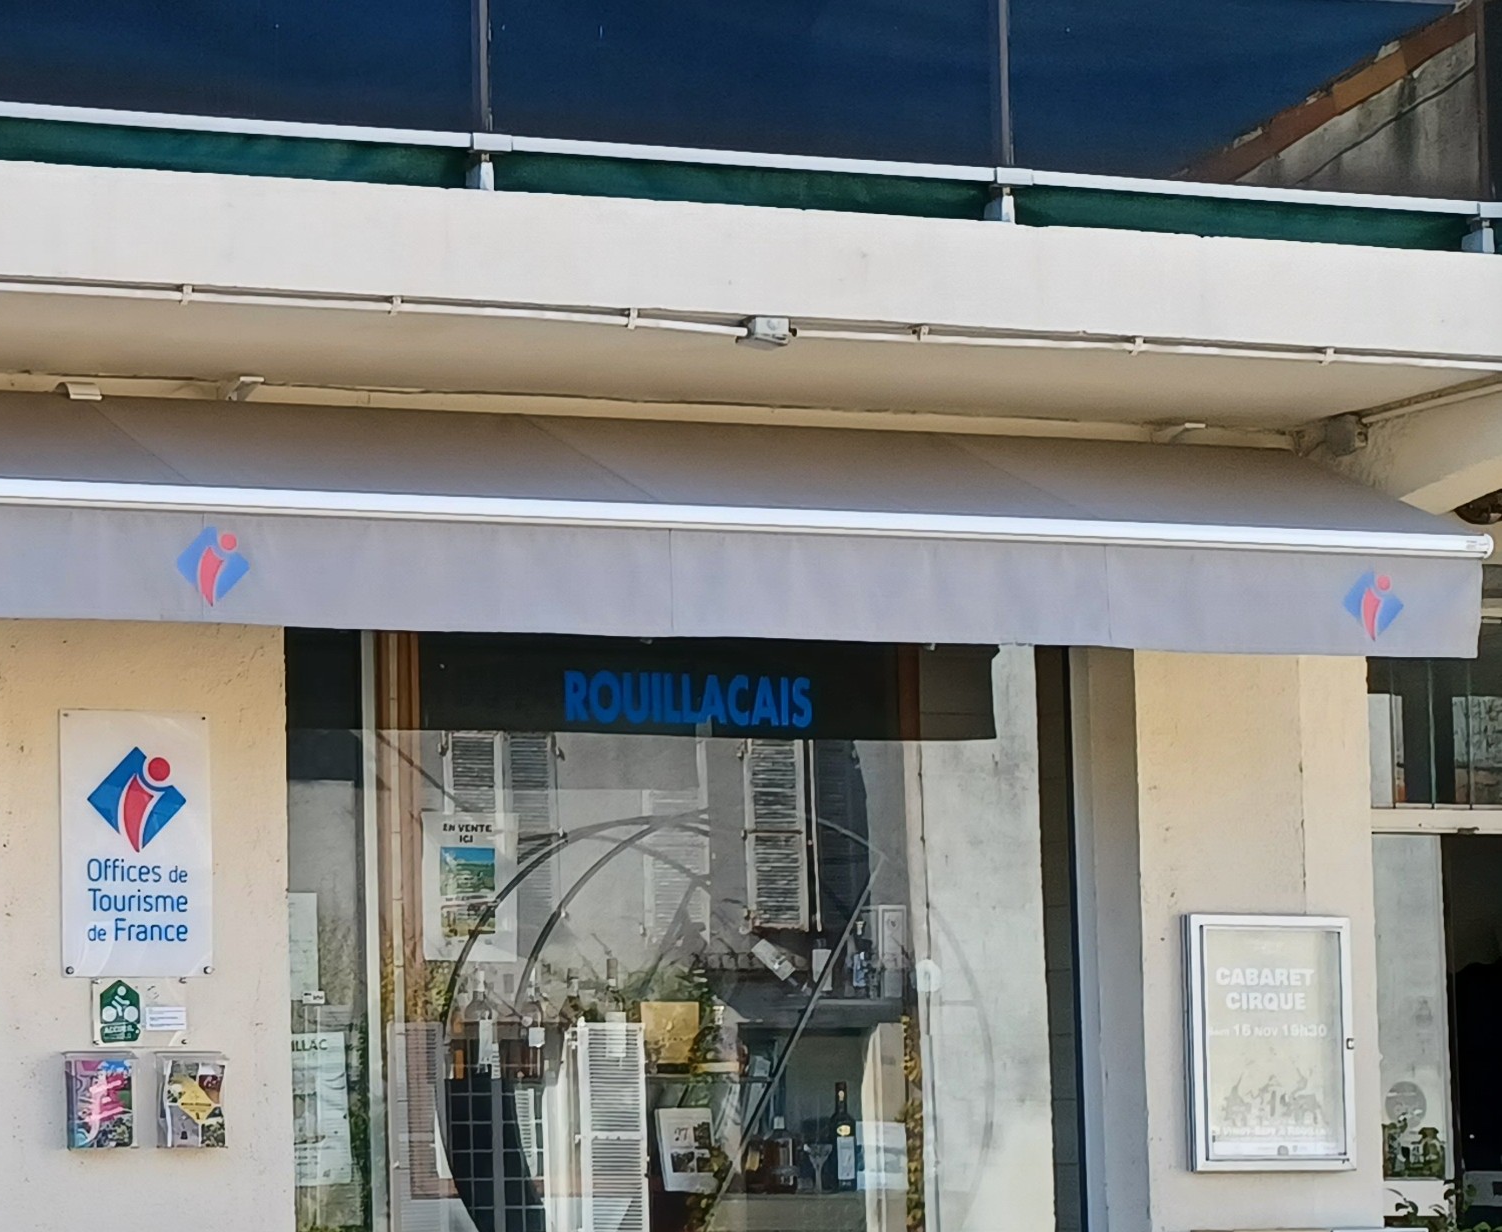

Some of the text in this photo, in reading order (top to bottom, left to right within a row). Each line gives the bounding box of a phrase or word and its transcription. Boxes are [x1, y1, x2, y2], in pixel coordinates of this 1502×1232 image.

[564, 670, 813, 728] ROUILLACAIS
[442, 823, 492, 833] EN VENTE
[459, 834, 474, 843] ICI
[87, 858, 188, 883] Offices de
[87, 888, 188, 912] Tourisme
[87, 917, 188, 942] de France
[1215, 967, 1315, 986] CABARET
[1225, 992, 1307, 1011] CIRQUE
